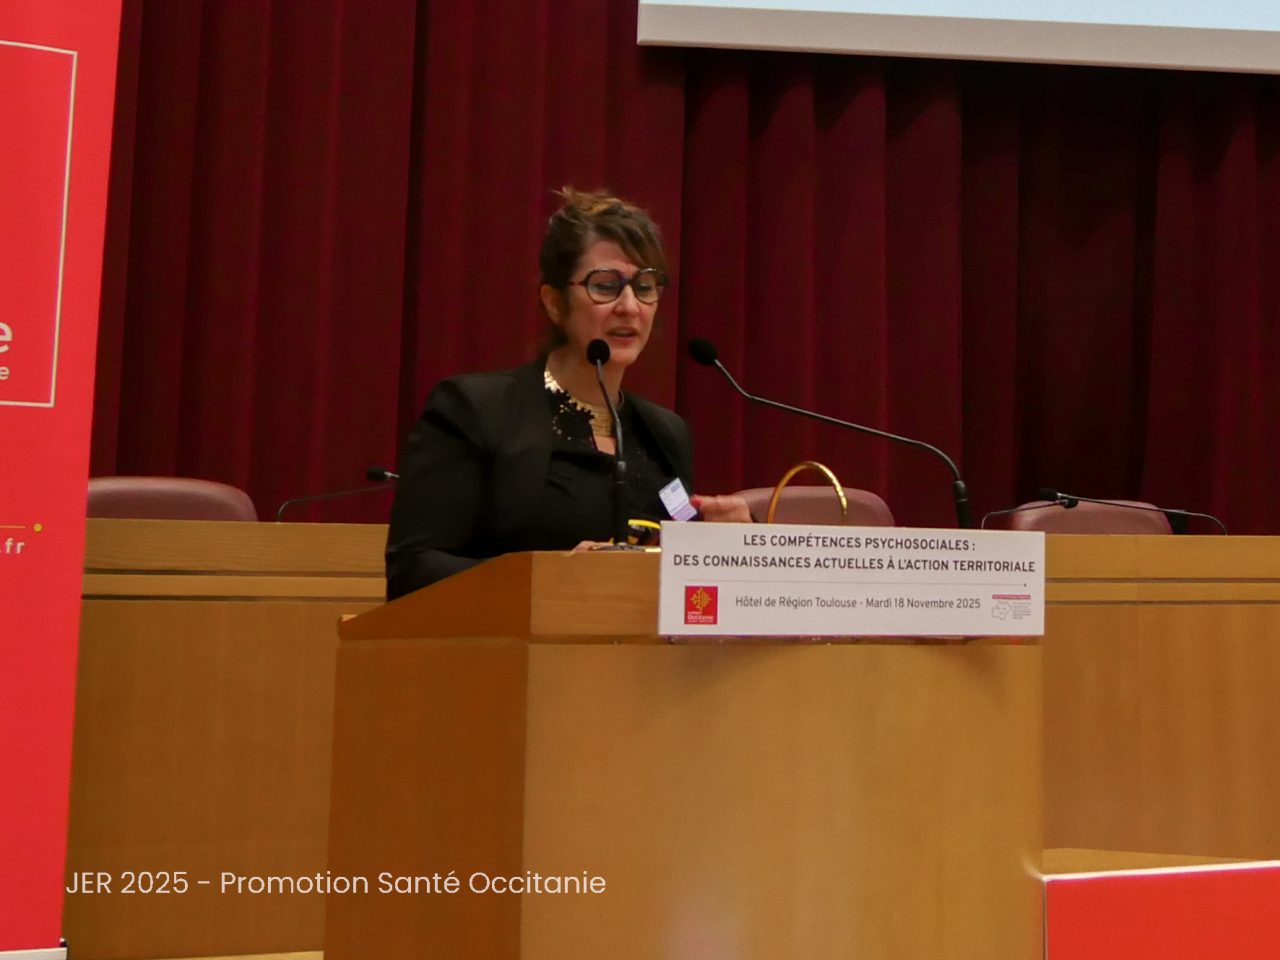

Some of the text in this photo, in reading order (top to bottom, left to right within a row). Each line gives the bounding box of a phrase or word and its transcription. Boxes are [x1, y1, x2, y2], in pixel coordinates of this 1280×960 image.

[744, 534, 766, 546] LES
[770, 533, 861, 549] COMPÉTENCES
[865, 538, 969, 551] PSYCHOSOCIALES
[673, 554, 1036, 572] DES CONNAISSANCES ACTUELLES À L'ACTION TERRITORIALE
[736, 595, 762, 607] Hôtel
[764, 596, 776, 608] de
[779, 596, 813, 610] Région
[815, 597, 857, 608] Toulouse
[865, 597, 892, 608] Mardi
[894, 598, 904, 608] 18
[906, 598, 954, 609] Novembre
[956, 598, 981, 609] 2025
